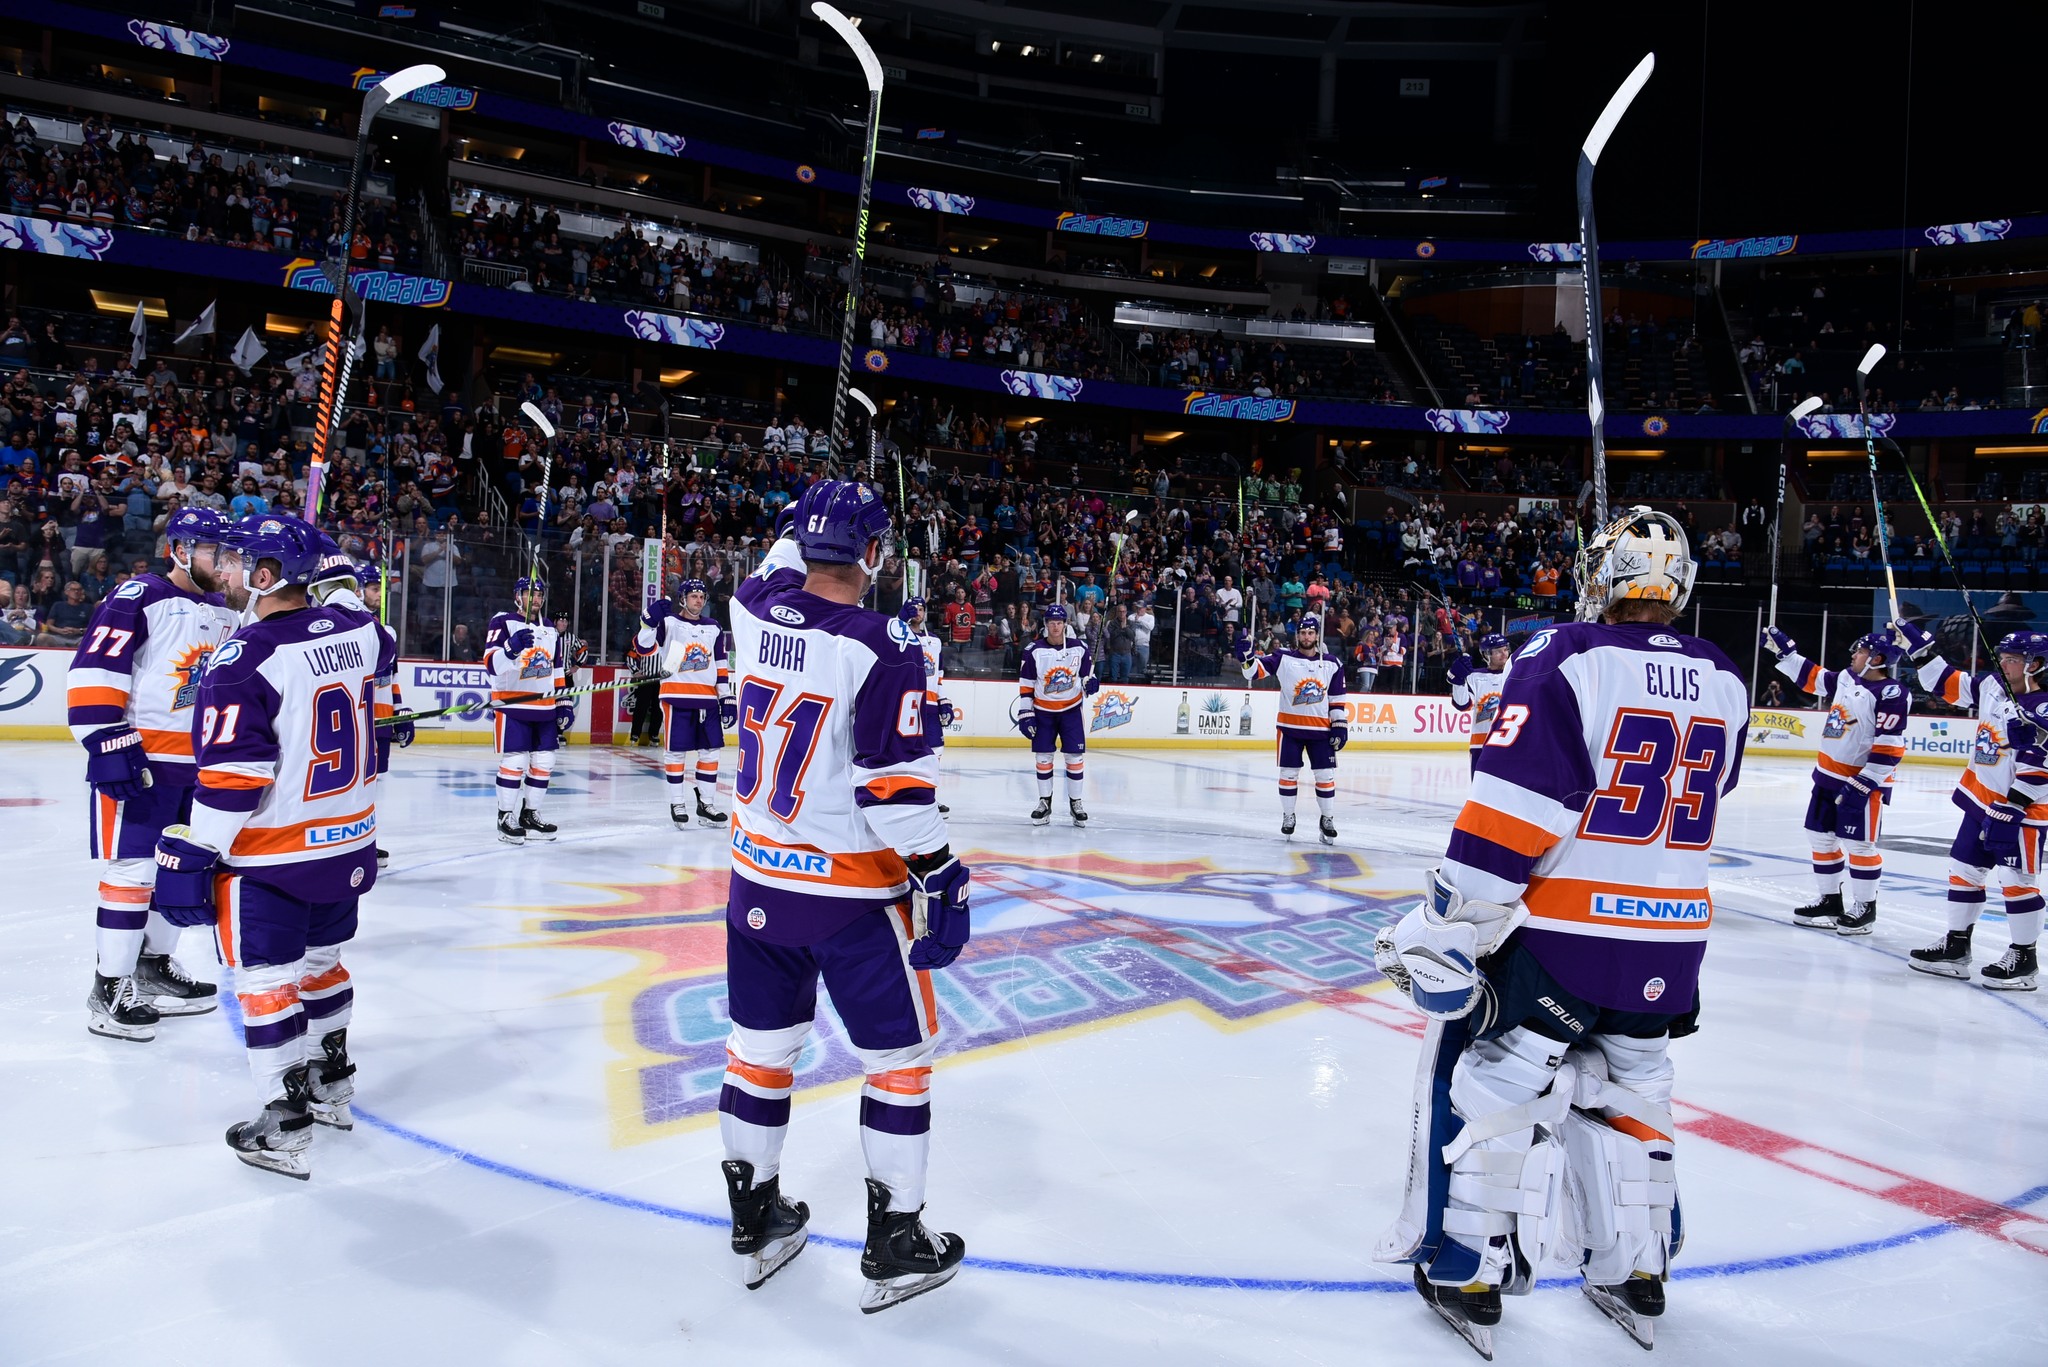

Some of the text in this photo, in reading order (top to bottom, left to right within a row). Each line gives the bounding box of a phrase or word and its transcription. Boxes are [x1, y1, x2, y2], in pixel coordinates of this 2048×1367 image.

[856, 209, 869, 260] ALPHA
[332, 341, 356, 429] WARRIOR
[1864, 426, 1877, 471] CCM
[1777, 464, 1788, 504] CCM
[807, 515, 827, 534] 61
[1527, 501, 1552, 513] 18
[86, 626, 134, 658] 77
[303, 641, 364, 677] LUCHUK
[758, 630, 806, 673] BOKA
[1645, 662, 1700, 702] ELLIS
[200, 704, 241, 748] 91
[1198, 714, 1230, 728] DANO'S
[1413, 703, 1472, 734] Silve
[1764, 713, 1797, 730] GREEK
[1875, 712, 1900, 730] 20
[303, 674, 378, 802] 91
[735, 674, 835, 825] 61
[1575, 707, 1727, 851] 33
[1595, 896, 1708, 919] LENNAR
[1413, 967, 1445, 984] MACH
